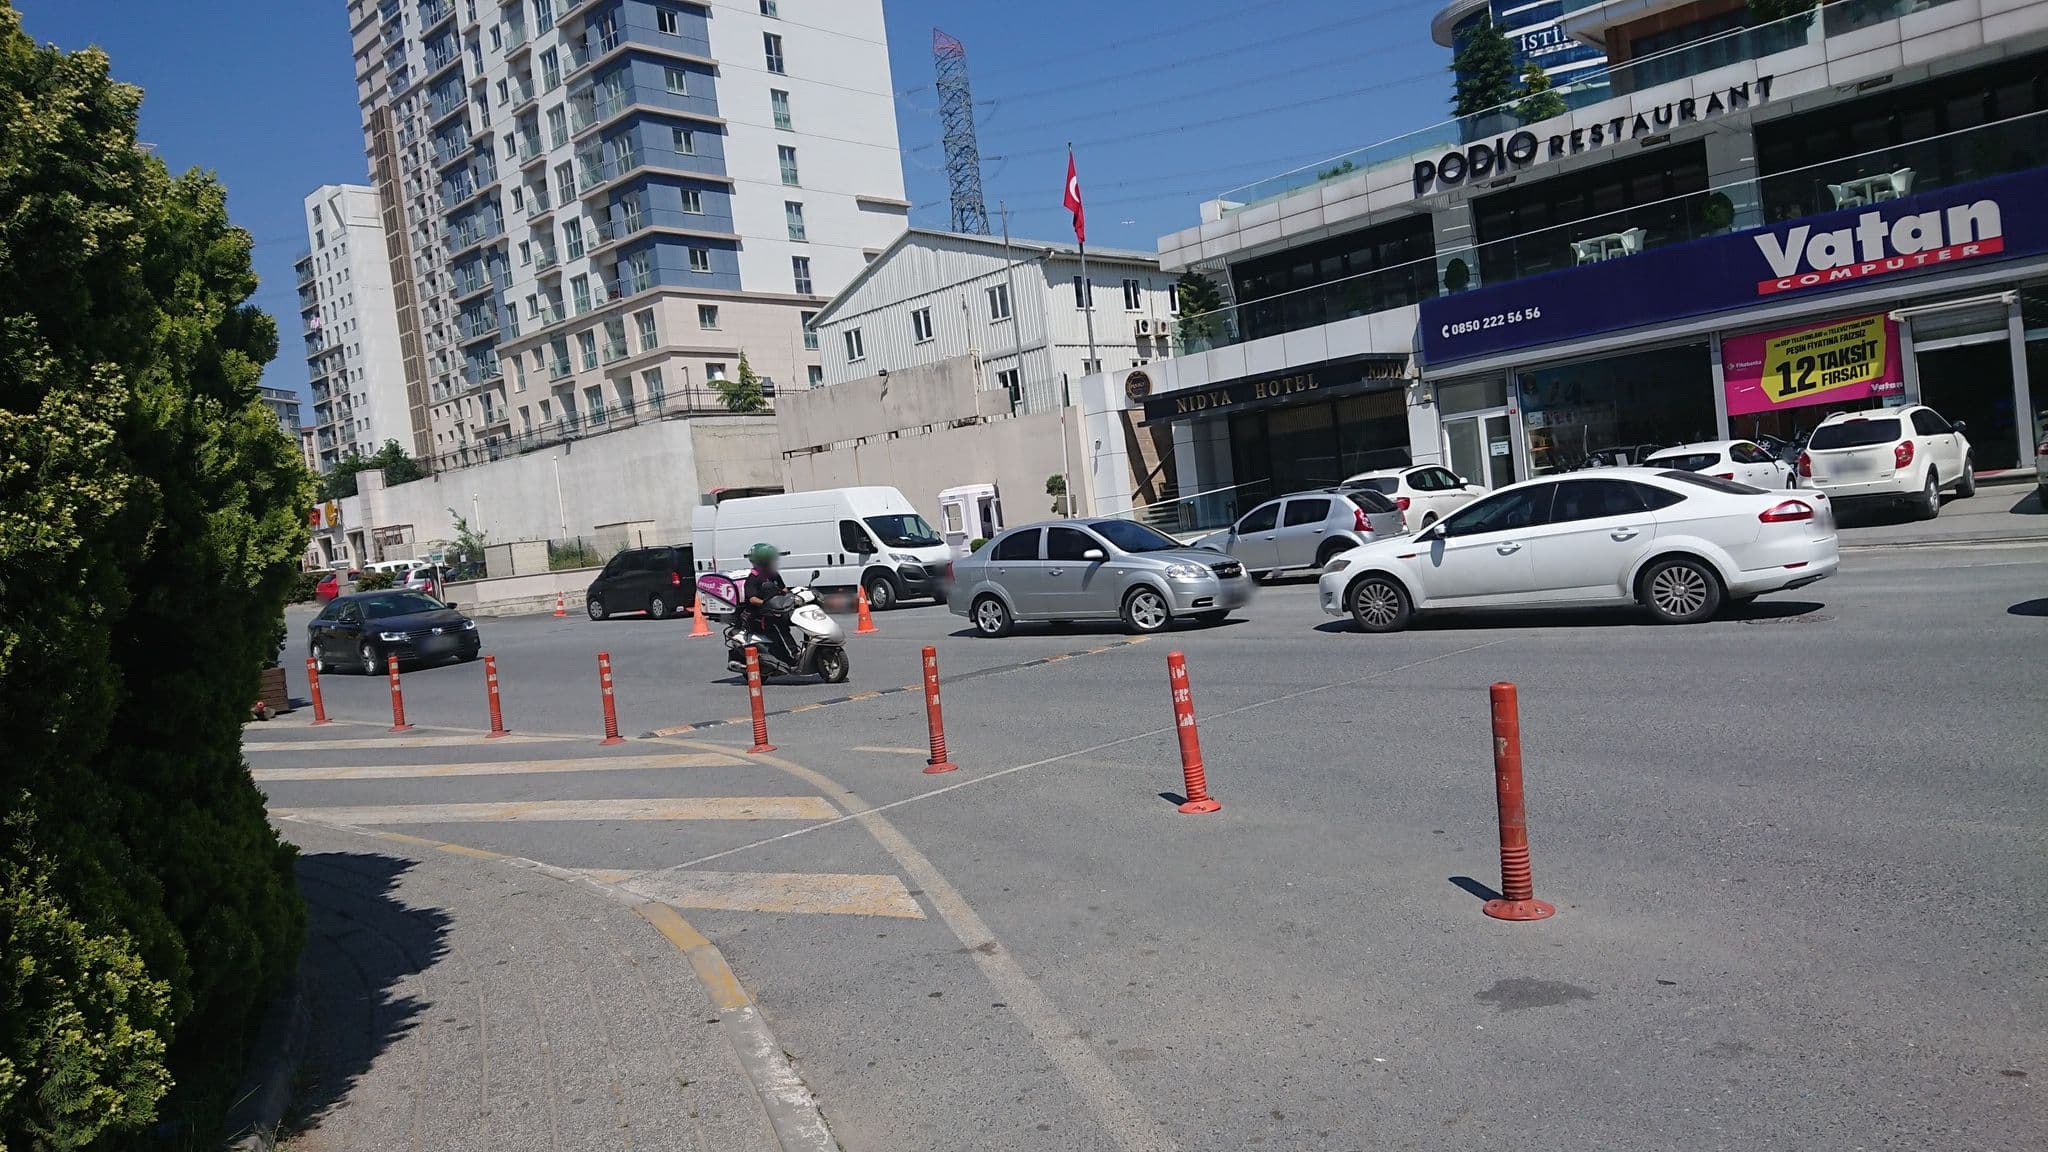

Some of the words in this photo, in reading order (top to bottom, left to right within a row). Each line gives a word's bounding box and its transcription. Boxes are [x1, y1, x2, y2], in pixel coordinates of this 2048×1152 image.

[1520, 26, 1568, 52] İSTİ
[1413, 130, 1538, 195] PODIO
[1549, 74, 1775, 158] RESTAURANT
[1753, 199, 2002, 279] Vatan
[1776, 245, 1981, 290] COMPUTER
[1451, 319, 1480, 335] 0850
[1483, 314, 1505, 329] 222
[1507, 310, 1523, 324] 56
[1525, 306, 1541, 320] 56
[1775, 355, 1817, 397] 12
[1817, 339, 1879, 370] TAKSİT
[1821, 363, 1870, 387] FIRSATI
[1177, 390, 1232, 414] NIDYA
[1255, 373, 1320, 400] HOTEL
